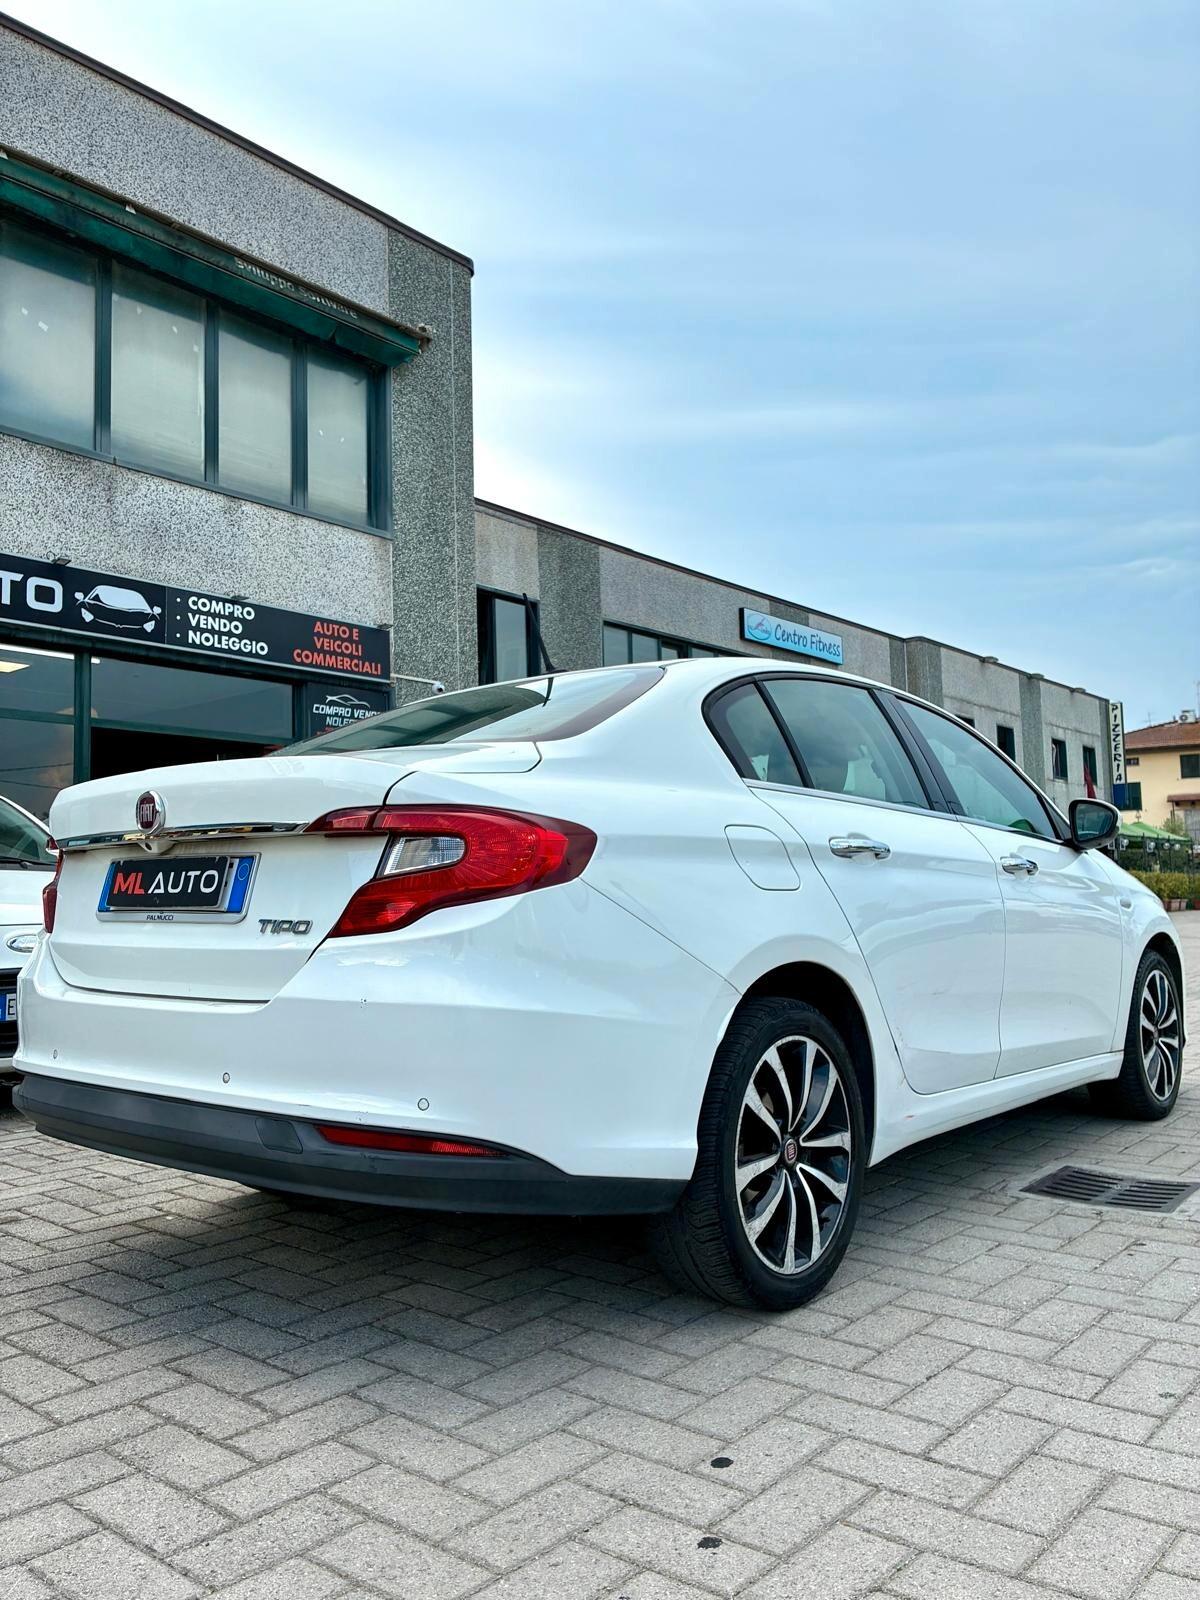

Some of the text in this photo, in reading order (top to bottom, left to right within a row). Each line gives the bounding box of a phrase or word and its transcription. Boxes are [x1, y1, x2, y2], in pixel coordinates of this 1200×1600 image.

[188, 596, 255, 620] COMPRO
[188, 612, 243, 635] VENDO
[313, 621, 360, 641] AUTO E
[188, 630, 269, 656] NOLEGGIO
[313, 636, 362, 657] VEICOLI
[774, 624, 808, 648] Centro
[810, 633, 841, 657] Fitness
[293, 649, 382, 675] COMMERCIALI
[312, 704, 352, 717] COMPRO
[1111, 703, 1123, 783] PIZZERIA
[113, 869, 219, 895] ML AUTO
[258, 918, 313, 935] TIPO
